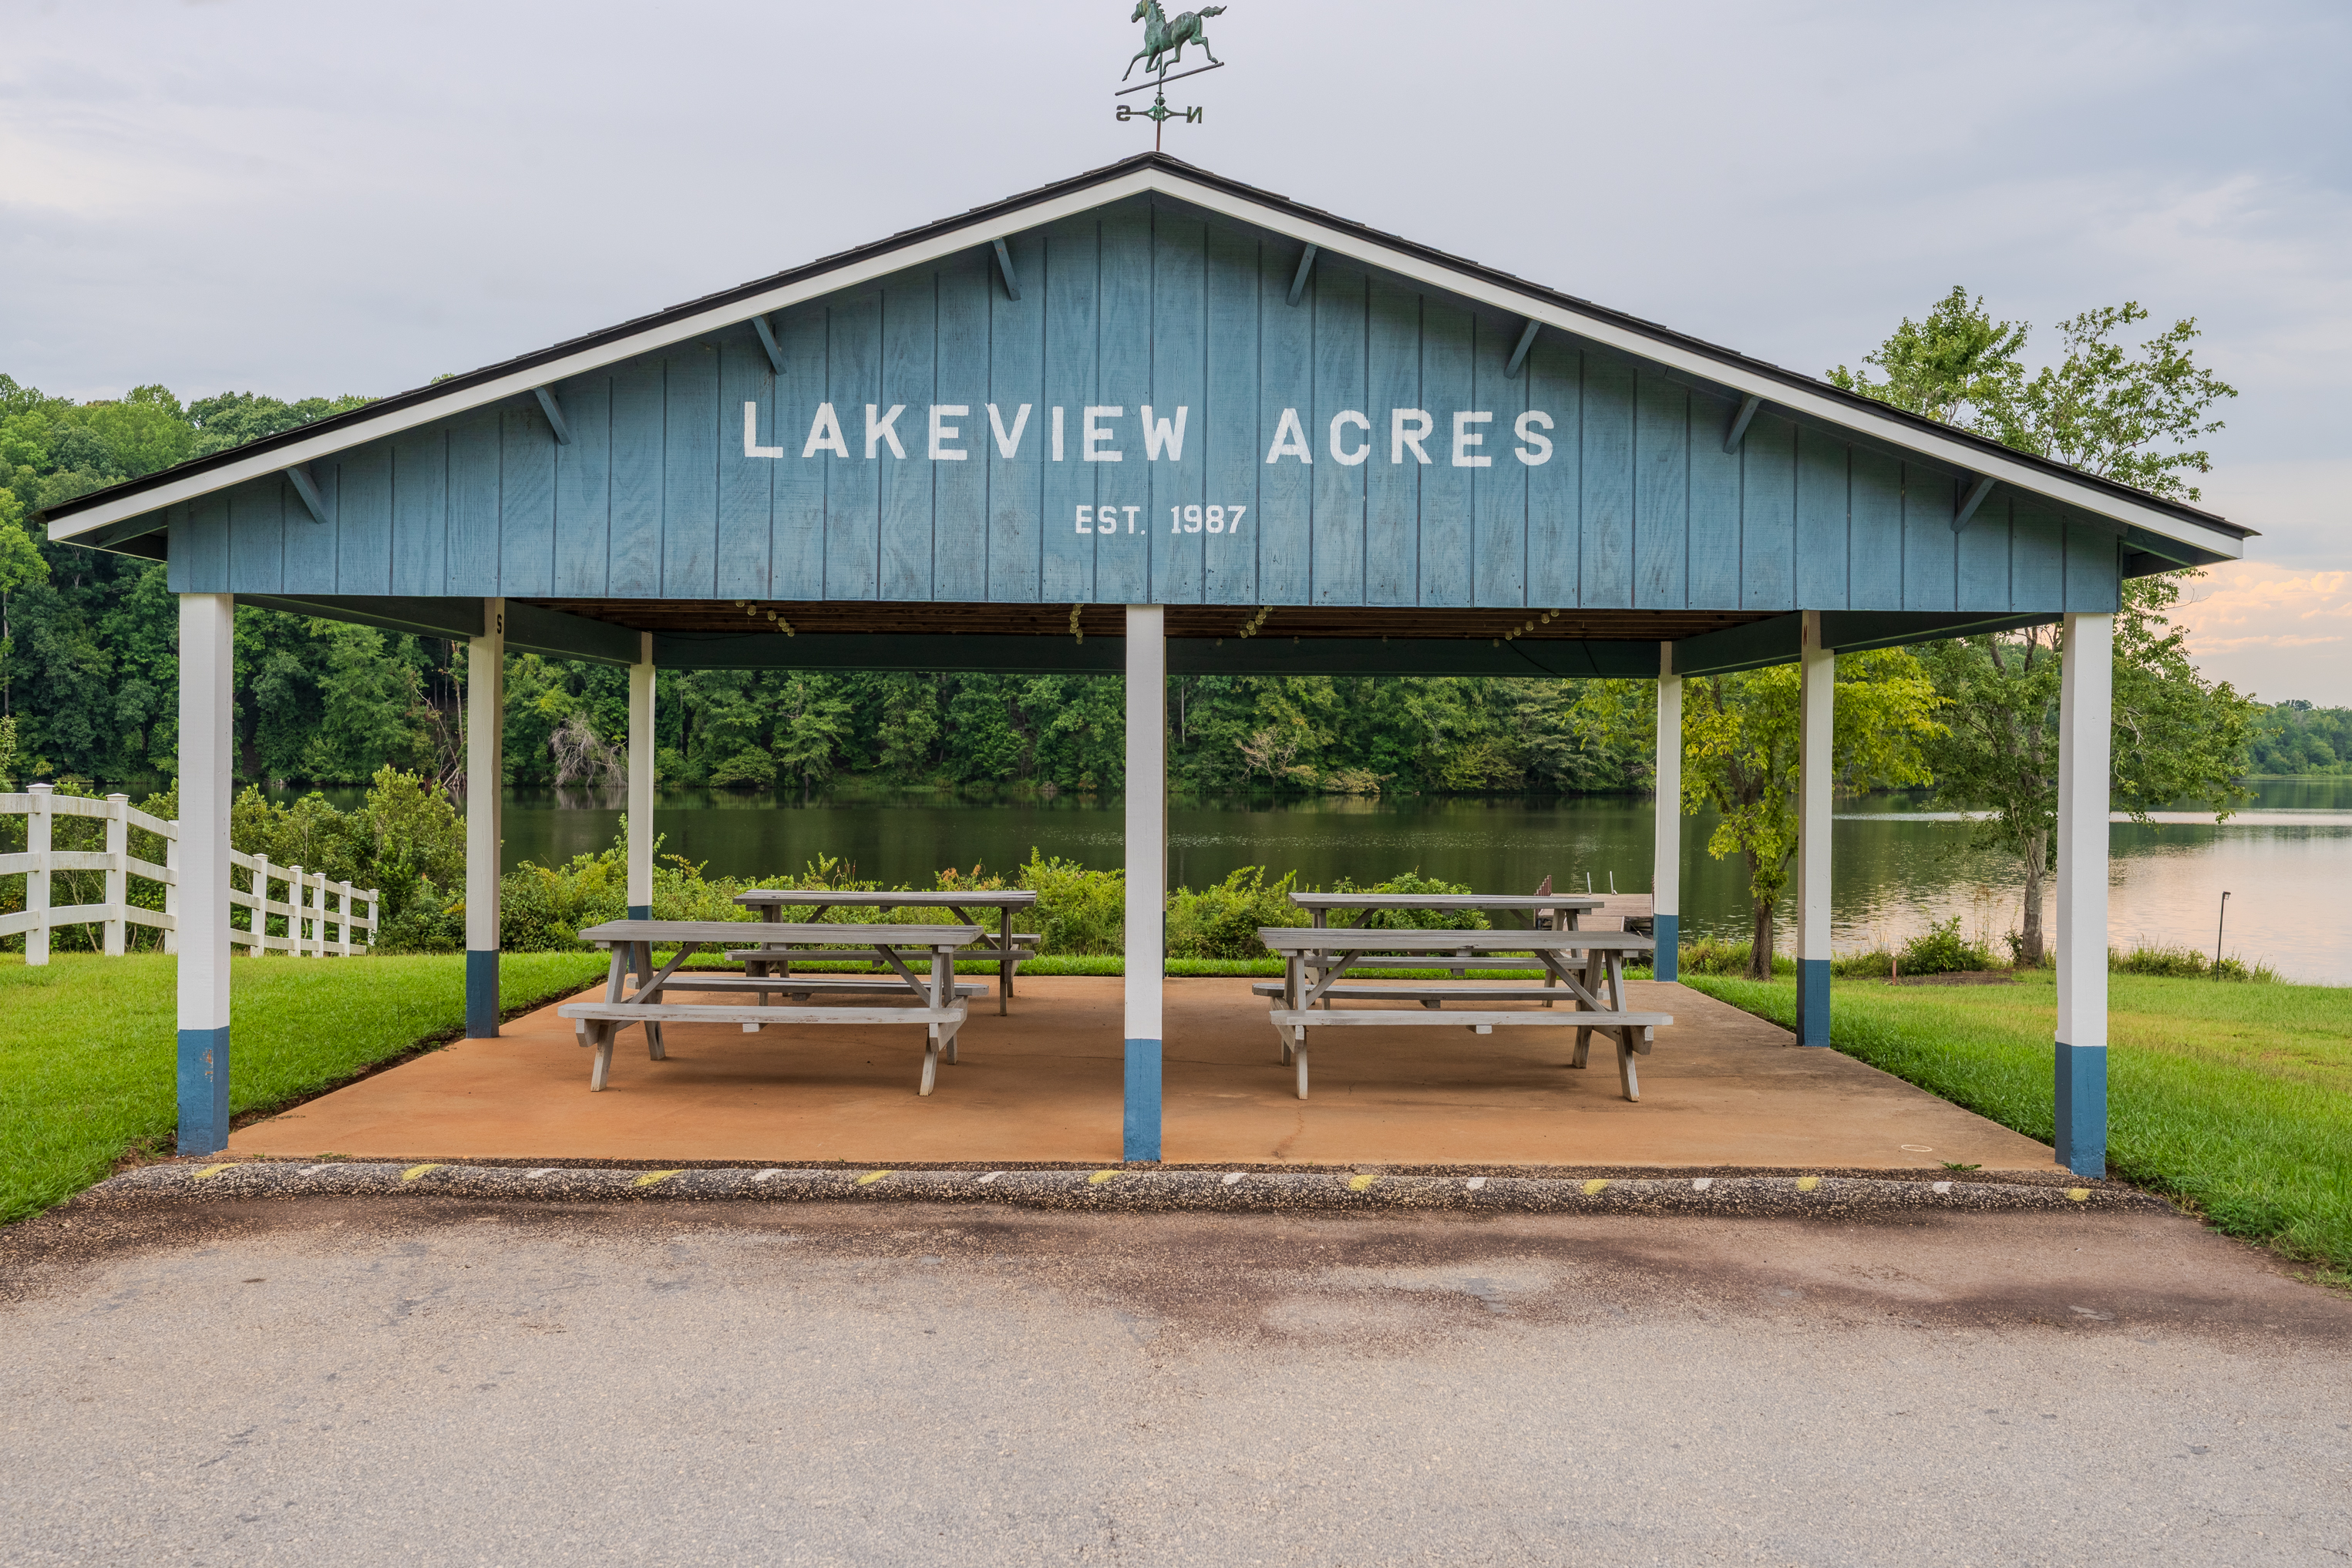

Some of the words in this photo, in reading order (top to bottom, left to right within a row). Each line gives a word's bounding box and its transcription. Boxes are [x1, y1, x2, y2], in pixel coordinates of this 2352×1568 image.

[744, 401, 1188, 462] LAKEVIEW
[1265, 408, 1555, 467] ACRES
[1075, 505, 1146, 535] EST.
[1170, 504, 1246, 534] 1987
